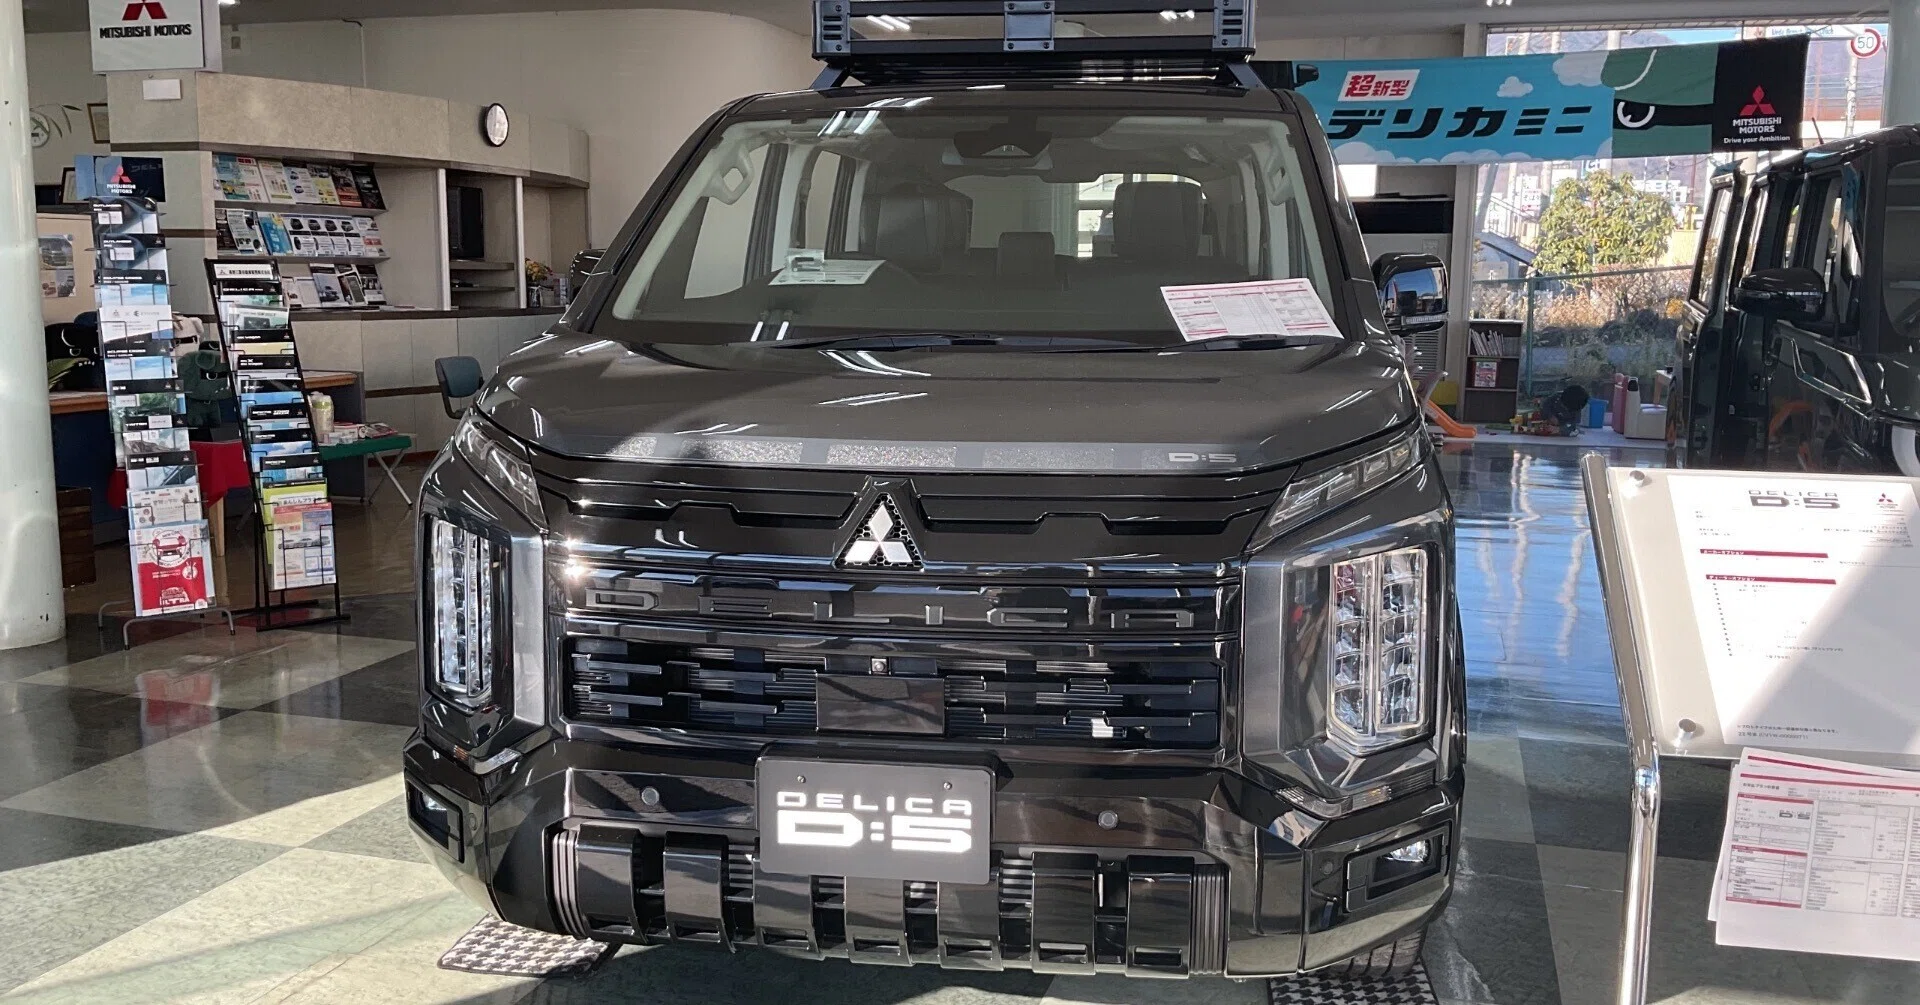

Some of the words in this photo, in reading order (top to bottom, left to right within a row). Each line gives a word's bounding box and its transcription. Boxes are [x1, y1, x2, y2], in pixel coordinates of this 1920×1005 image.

[99, 25, 152, 39] MITSUBISHI
[154, 23, 192, 37] MOTORS
[1856, 36, 1875, 49] 50
[1345, 74, 1411, 98] 超新型
[1326, 105, 1593, 140] デリカミニ
[1732, 116, 1782, 127] MITSUBISHI
[1738, 125, 1775, 134] MOTORS
[1759, 135, 1791, 143] Ambition
[1168, 453, 1237, 463] D:5
[1748, 489, 1838, 498] DELICA
[1750, 495, 1840, 509] D:5
[586, 587, 1195, 629] DELICA
[777, 791, 972, 816] DELICA
[777, 810, 972, 853] D:5
